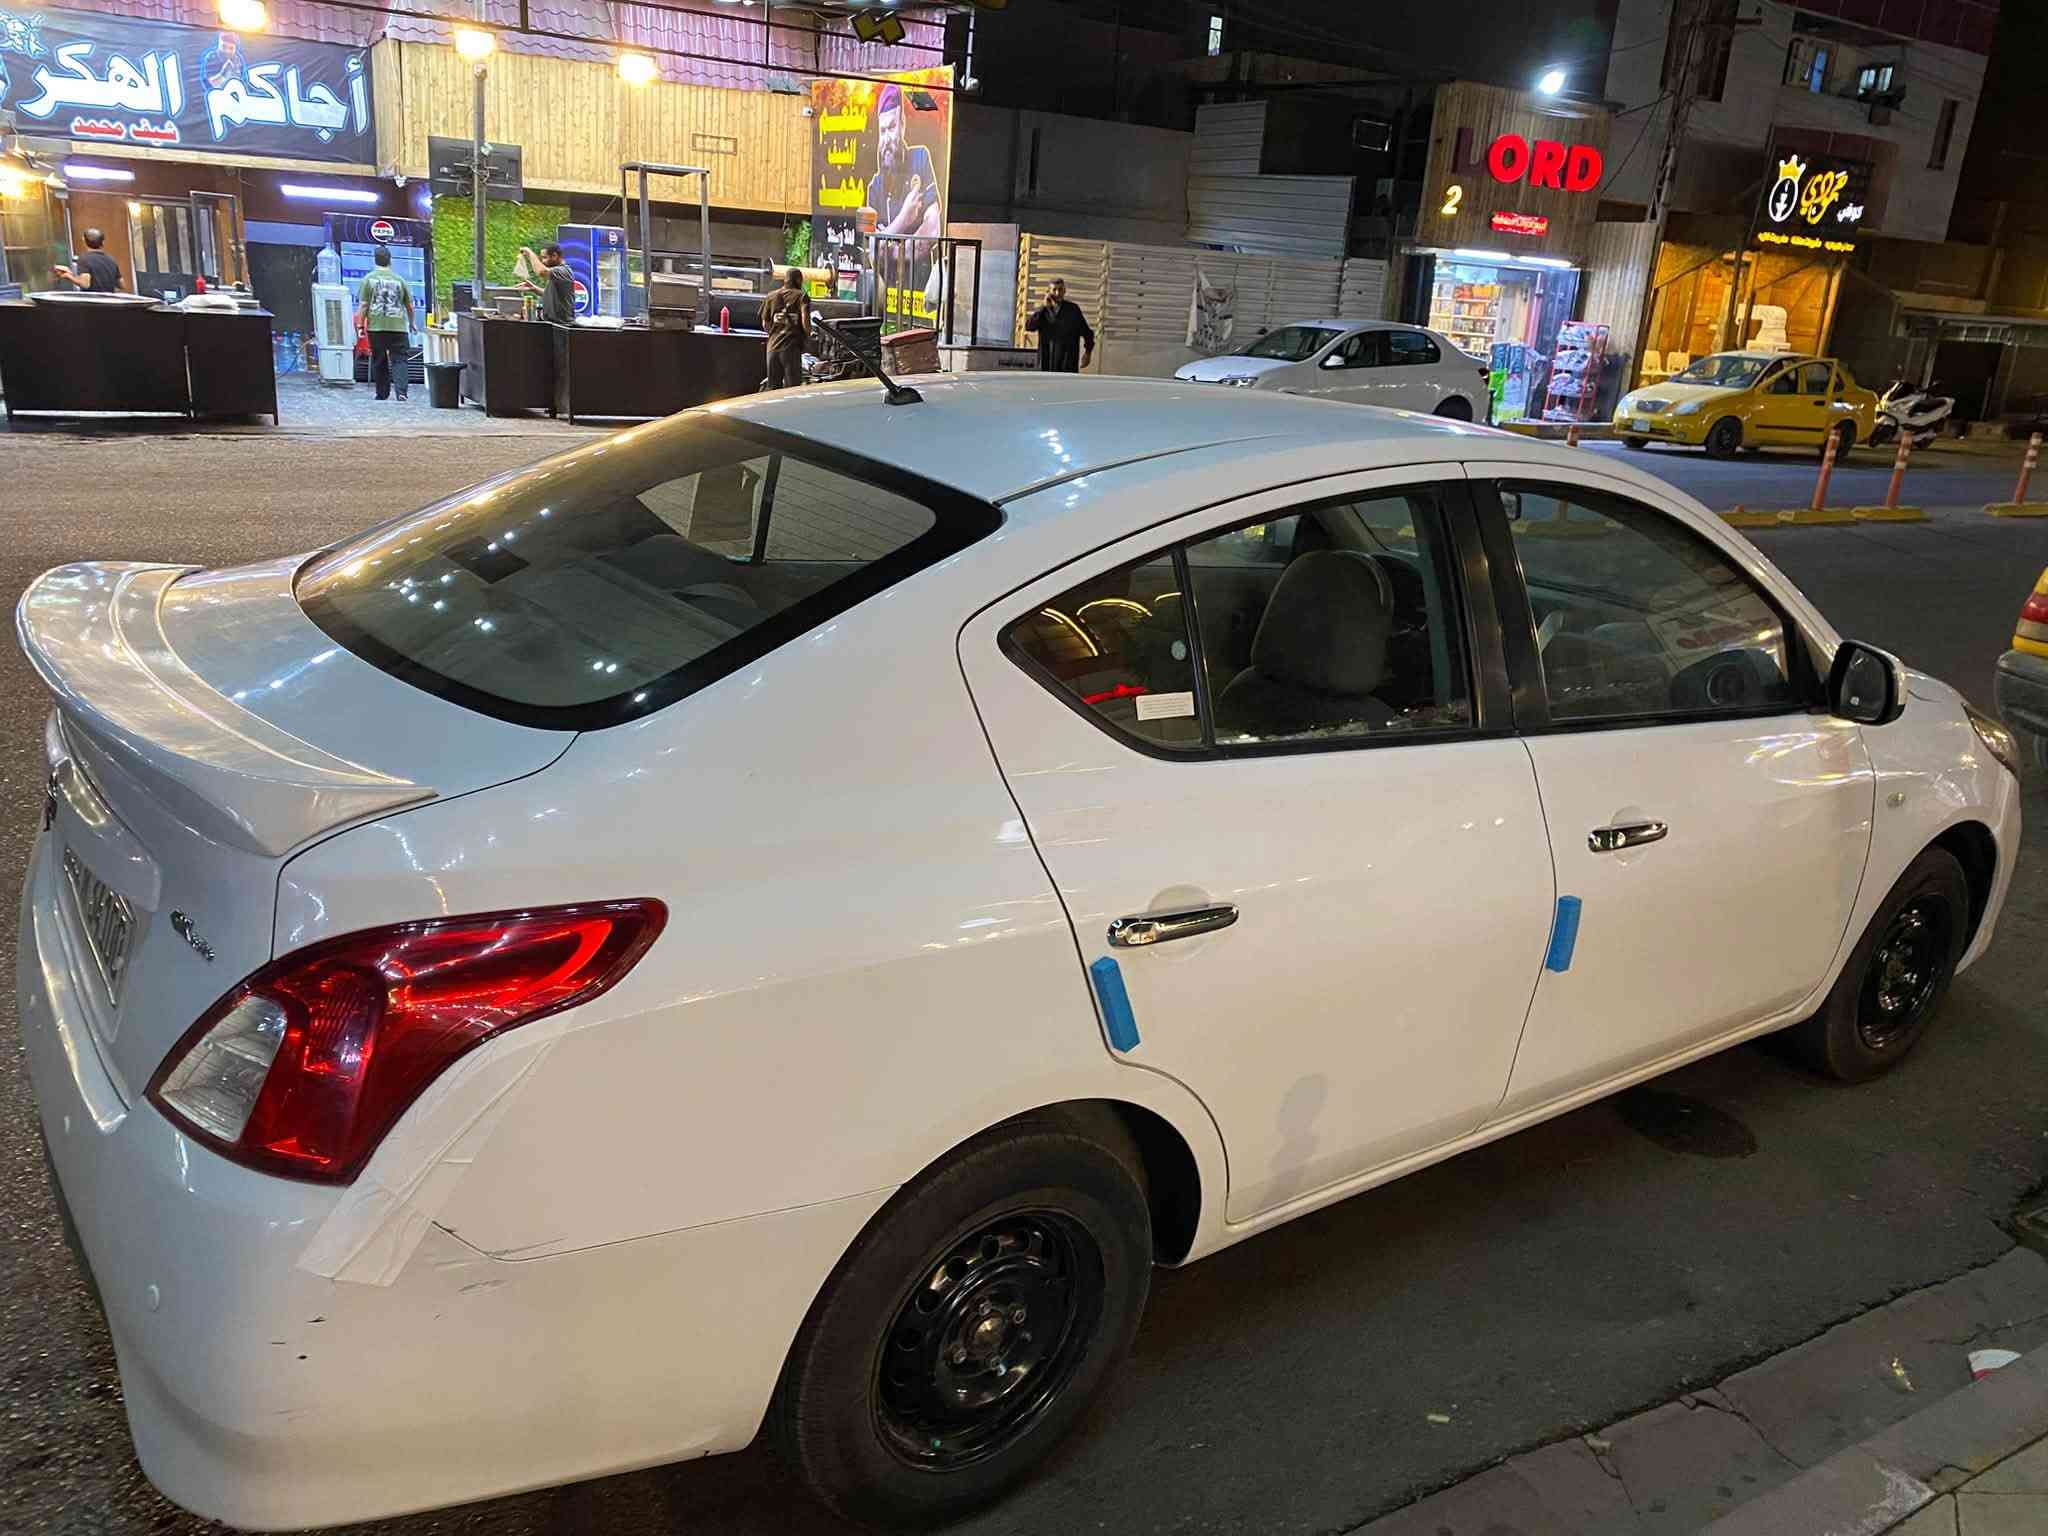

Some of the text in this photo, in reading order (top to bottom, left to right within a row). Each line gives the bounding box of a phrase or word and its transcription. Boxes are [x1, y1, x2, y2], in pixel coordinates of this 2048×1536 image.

[17, 41, 369, 142] أجاكم الهكر
[71, 117, 178, 144] شيف محمد
[1452, 127, 1603, 192] LORD
[1441, 184, 1463, 215] 2
